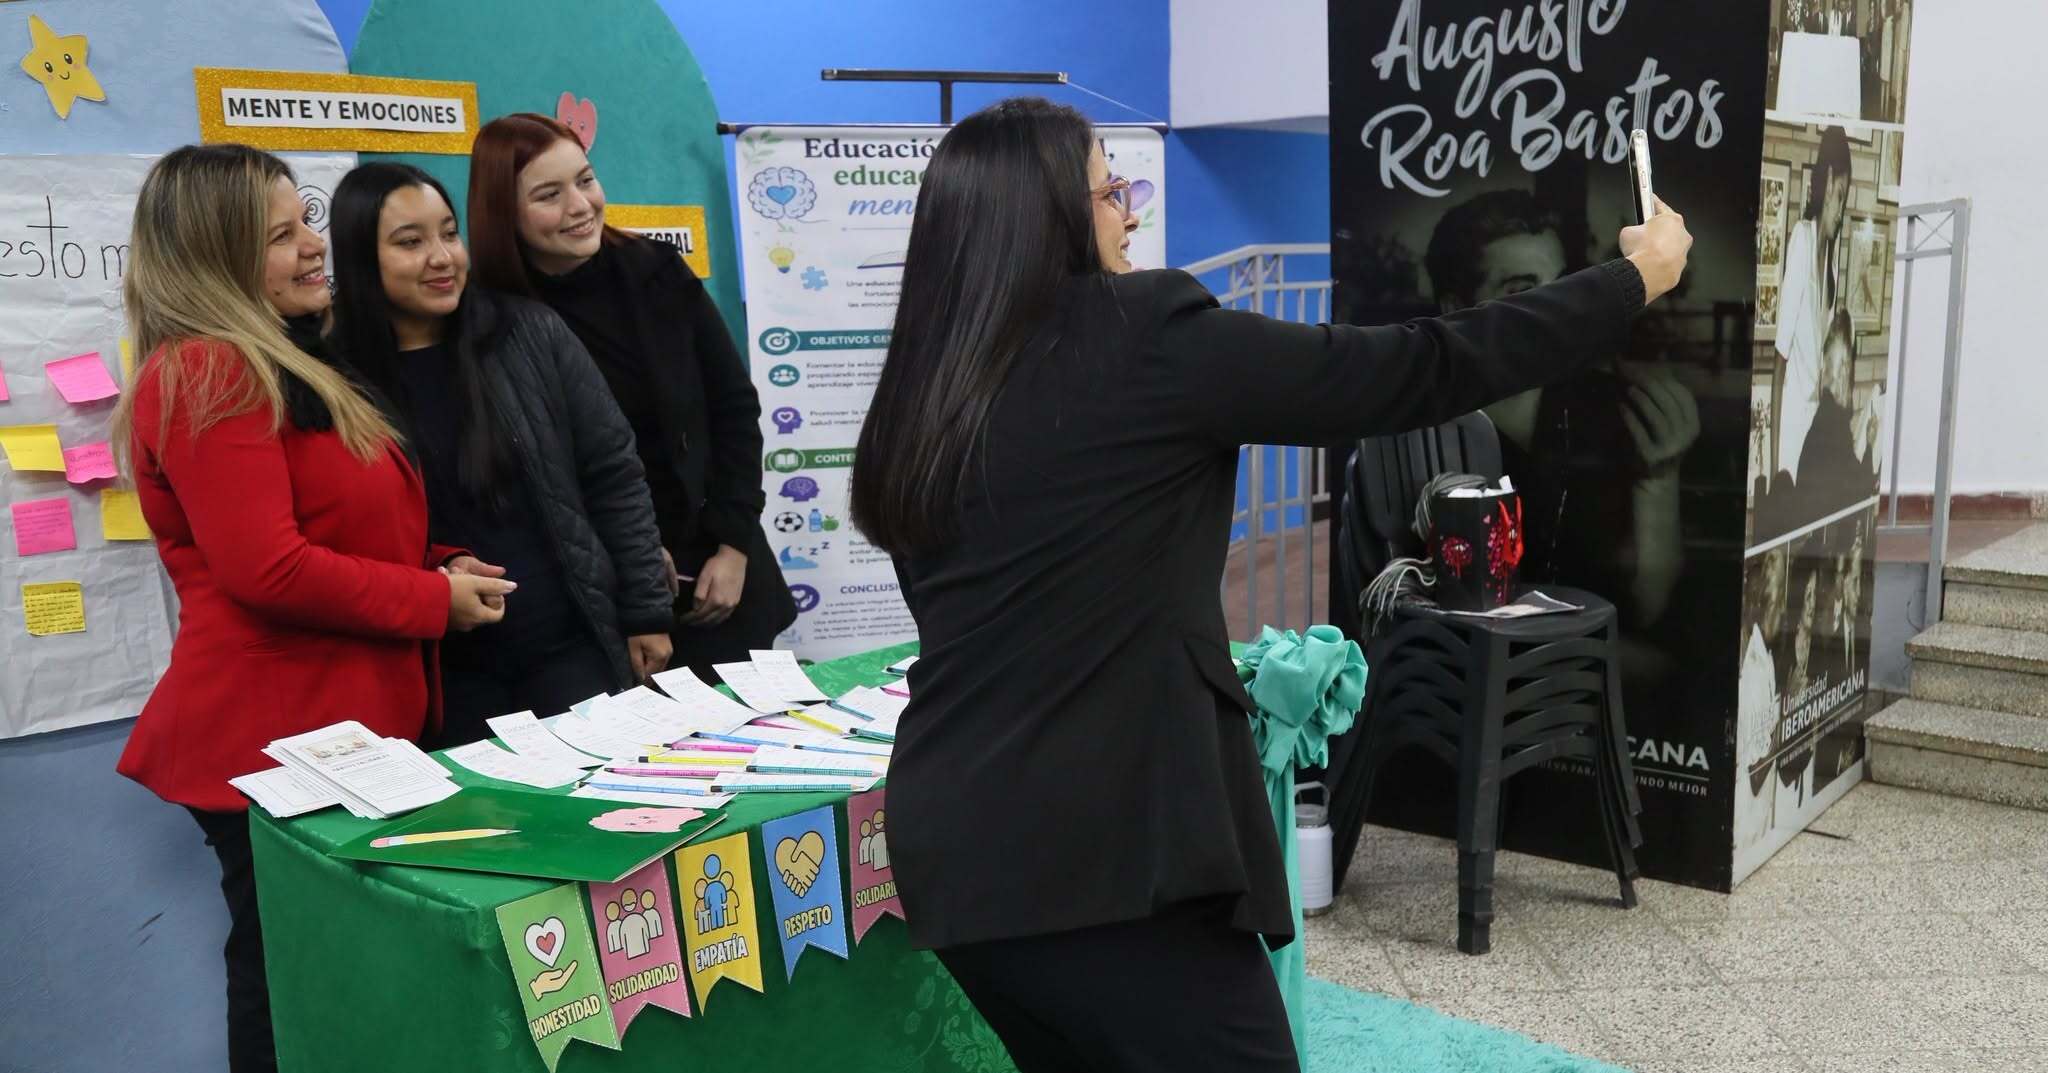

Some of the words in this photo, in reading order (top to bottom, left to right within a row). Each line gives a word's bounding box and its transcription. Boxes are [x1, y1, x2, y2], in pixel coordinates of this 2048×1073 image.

[1371, 0, 1626, 118] Augusto
[227, 97, 313, 119] MENTE
[317, 100, 332, 119] Y
[339, 101, 457, 124] EMOCIONES
[1361, 104, 1495, 197] Roa
[1490, 57, 1725, 172] Bastos
[804, 138, 937, 158] Educació
[810, 335, 870, 346] OBJETIVOS
[840, 583, 899, 594] CONCLUSI
[1782, 668, 1864, 743] IBEROAMERICANA
[1783, 670, 1827, 716] Universidad
[1668, 781, 1708, 796] MEJOR
[784, 904, 832, 941] RESPETO
[694, 933, 749, 973] EMPATÍA
[608, 962, 680, 1004] SOLIDARIDAD
[531, 994, 602, 1041] HONESTIDAD
